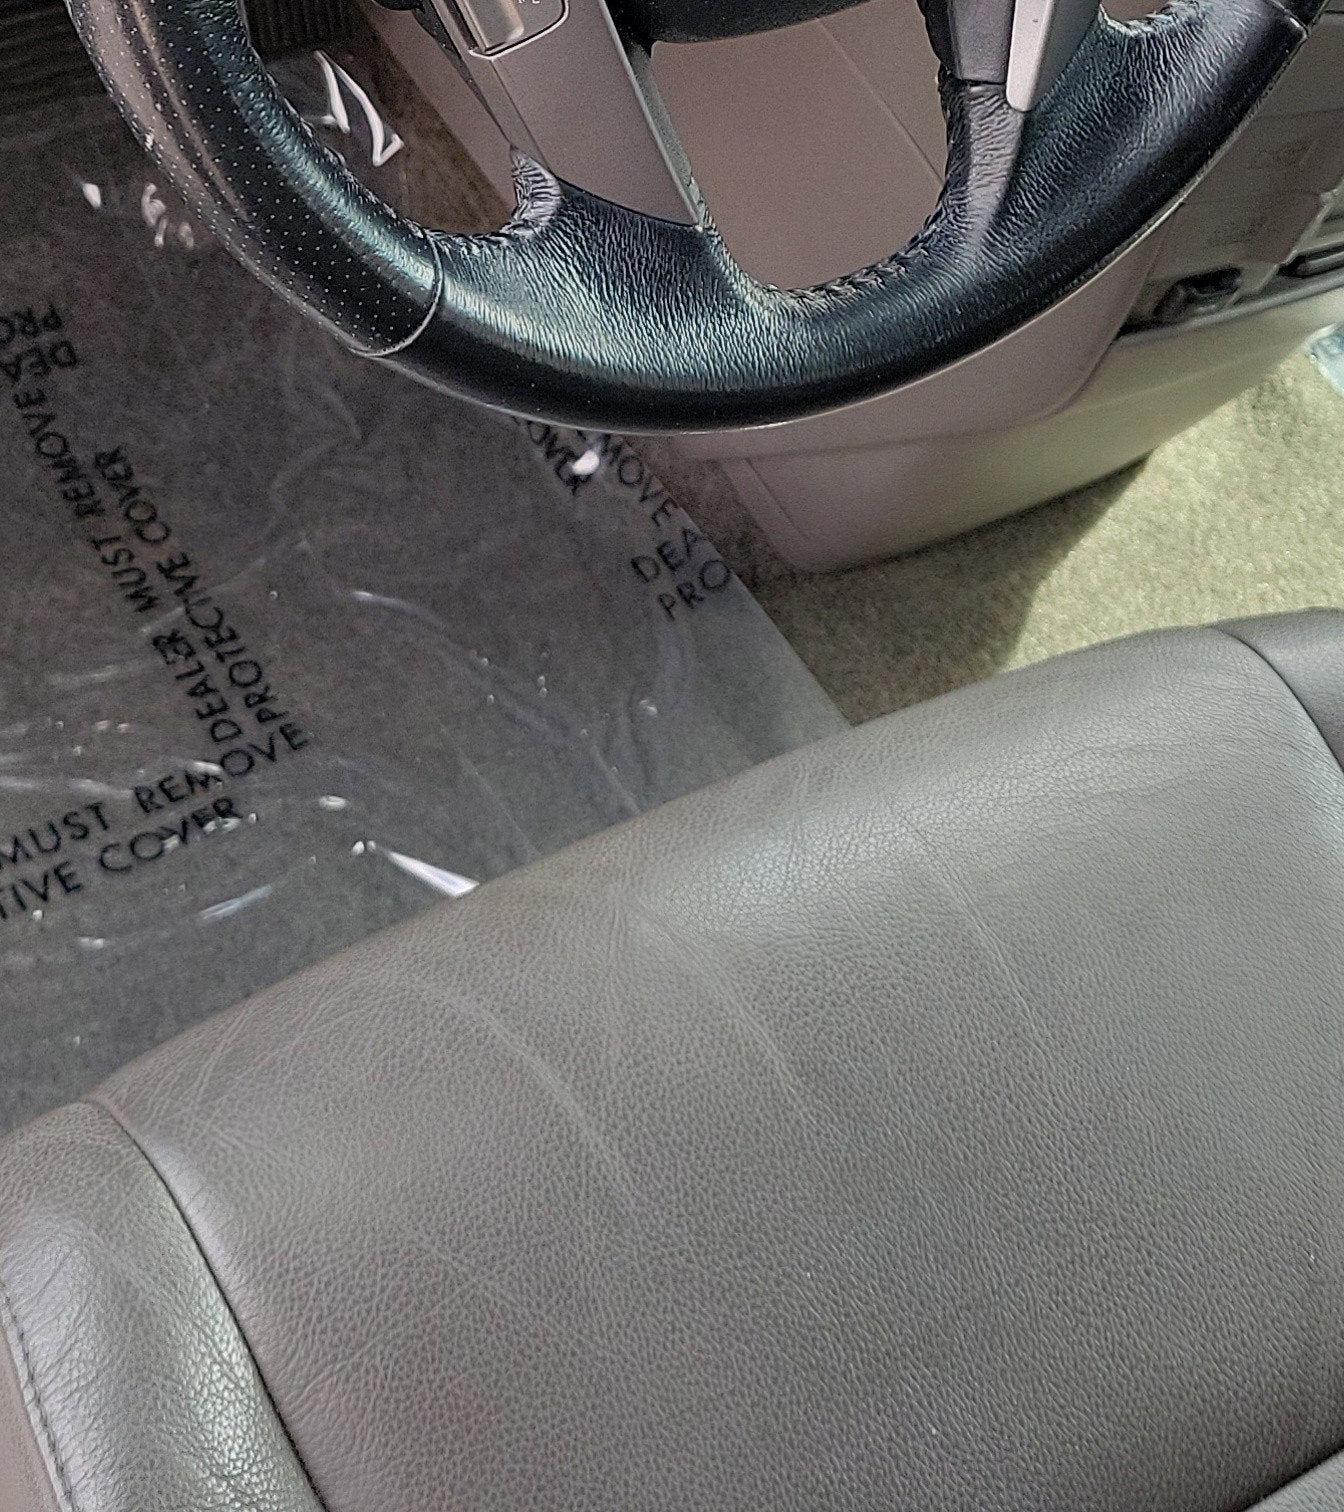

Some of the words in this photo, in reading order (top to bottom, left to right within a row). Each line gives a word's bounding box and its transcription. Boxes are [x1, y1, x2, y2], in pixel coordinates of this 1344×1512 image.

[91, 534, 159, 613] MUST
[132, 719, 309, 814] REMOVE
[99, 796, 241, 874] COVER
